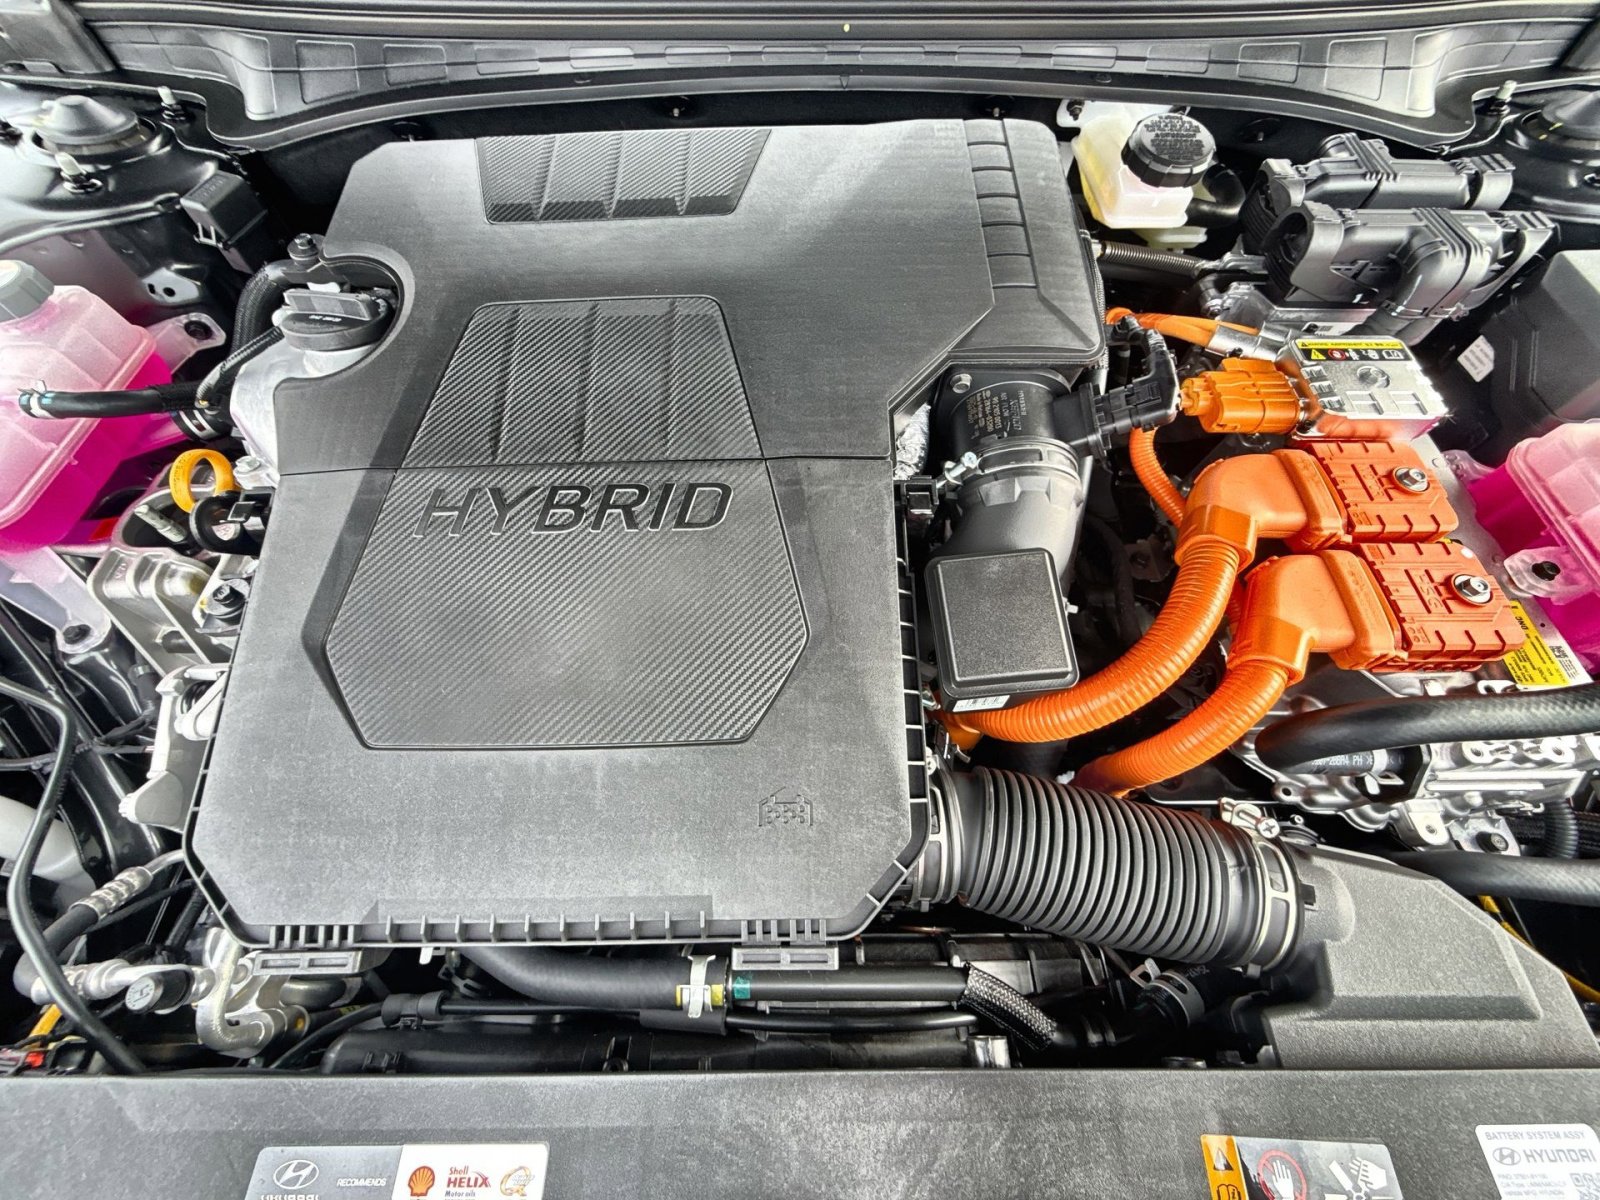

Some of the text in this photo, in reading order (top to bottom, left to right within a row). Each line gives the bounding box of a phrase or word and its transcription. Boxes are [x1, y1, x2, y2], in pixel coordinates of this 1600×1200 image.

[412, 482, 733, 537] HYBRID
[1485, 1130, 1586, 1141] BATTERY SYSTEM ASSY
[1523, 1149, 1598, 1164] HYUNDAI
[449, 1165, 469, 1176] Shell
[336, 1177, 388, 1188] RECOMMENDS
[446, 1172, 492, 1188] HELIX
